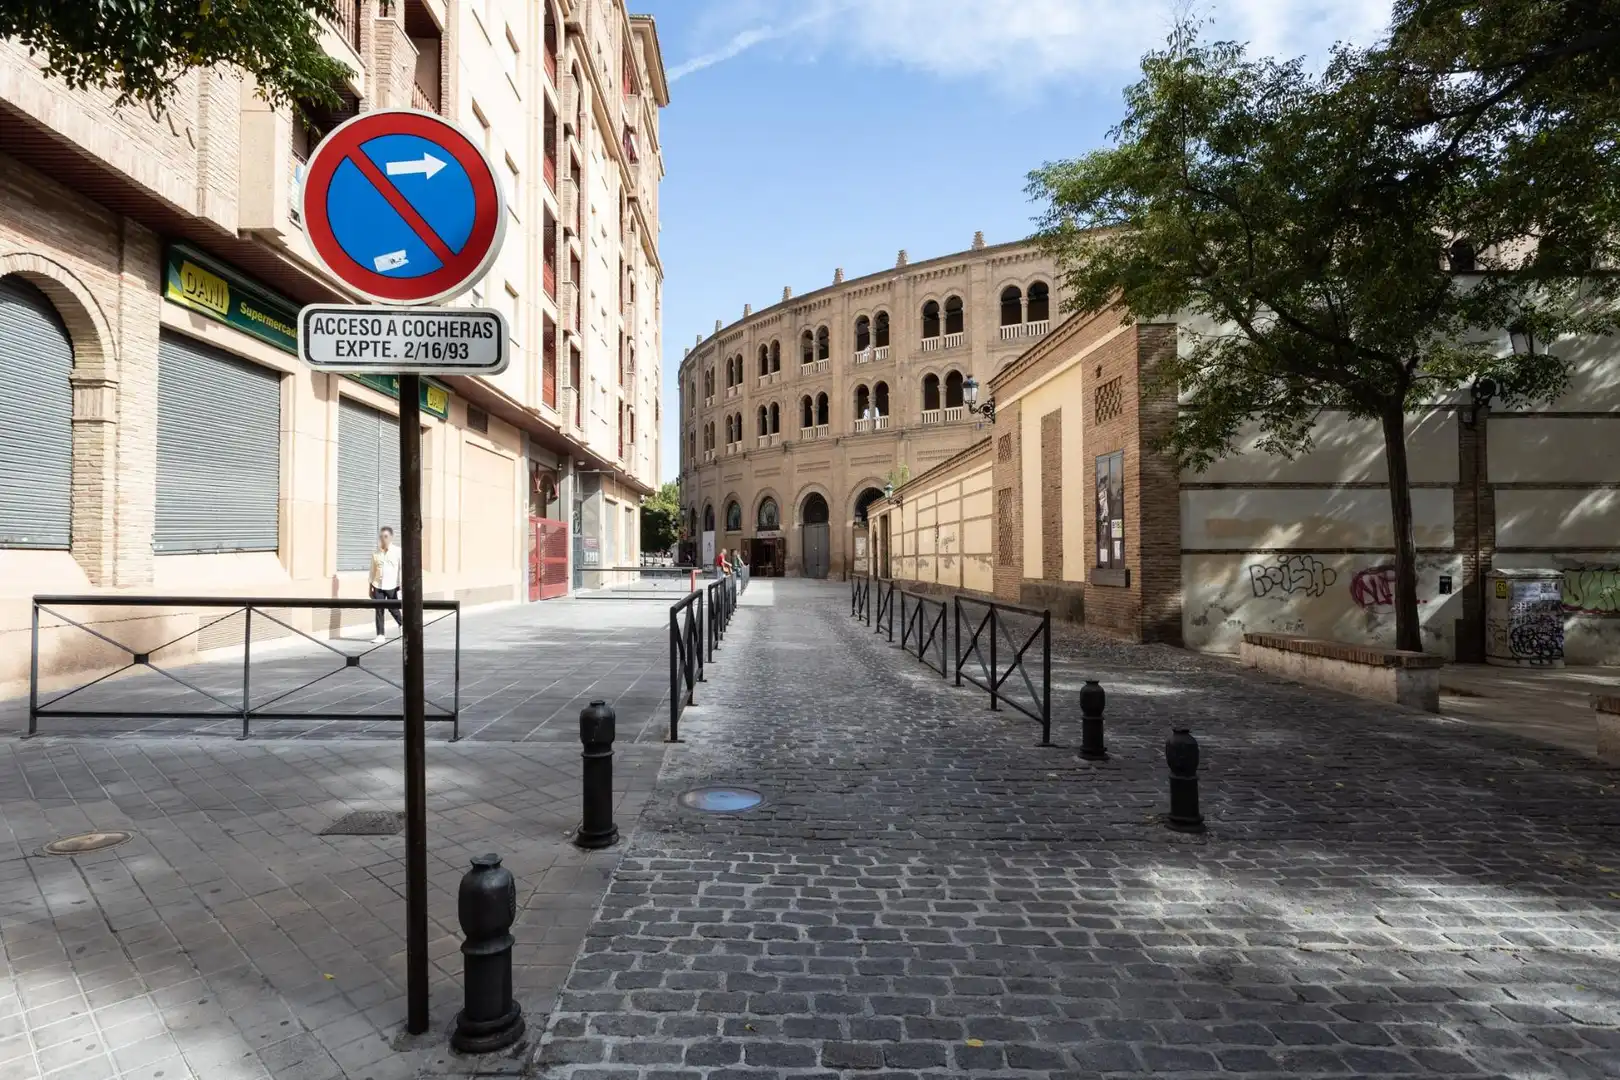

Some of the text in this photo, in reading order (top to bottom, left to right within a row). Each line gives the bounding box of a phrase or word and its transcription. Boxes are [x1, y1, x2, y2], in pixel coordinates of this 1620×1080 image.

[186, 272, 225, 309] DANI
[240, 302, 298, 339] Supermercad
[313, 318, 494, 339] ACCESO A COCHERAS
[335, 340, 469, 360] EXPTE. 2/16/93
